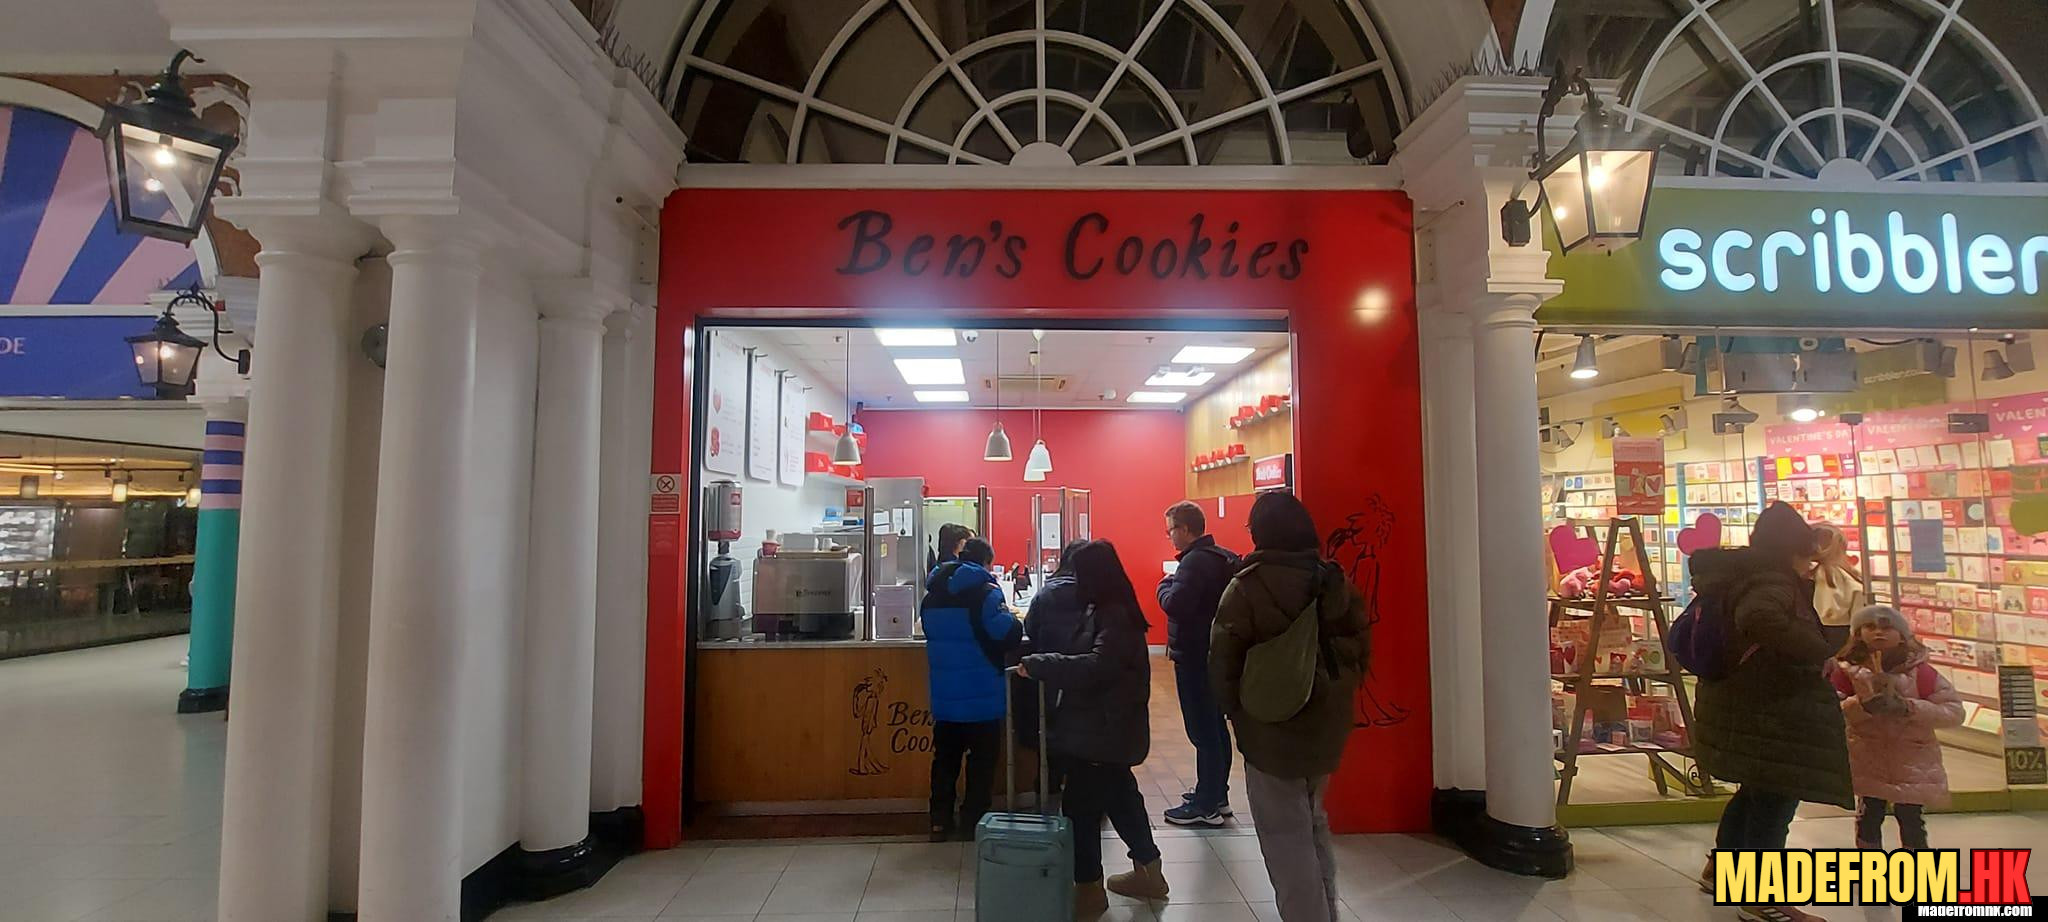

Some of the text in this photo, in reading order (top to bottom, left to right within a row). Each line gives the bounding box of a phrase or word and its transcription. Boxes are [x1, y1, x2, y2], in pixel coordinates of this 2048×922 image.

[835, 209, 1310, 280] Ben's Cookies
[1658, 207, 2048, 295] scribbler
[1996, 407, 2048, 422] VALEN
[2007, 750, 2043, 769] 10%
